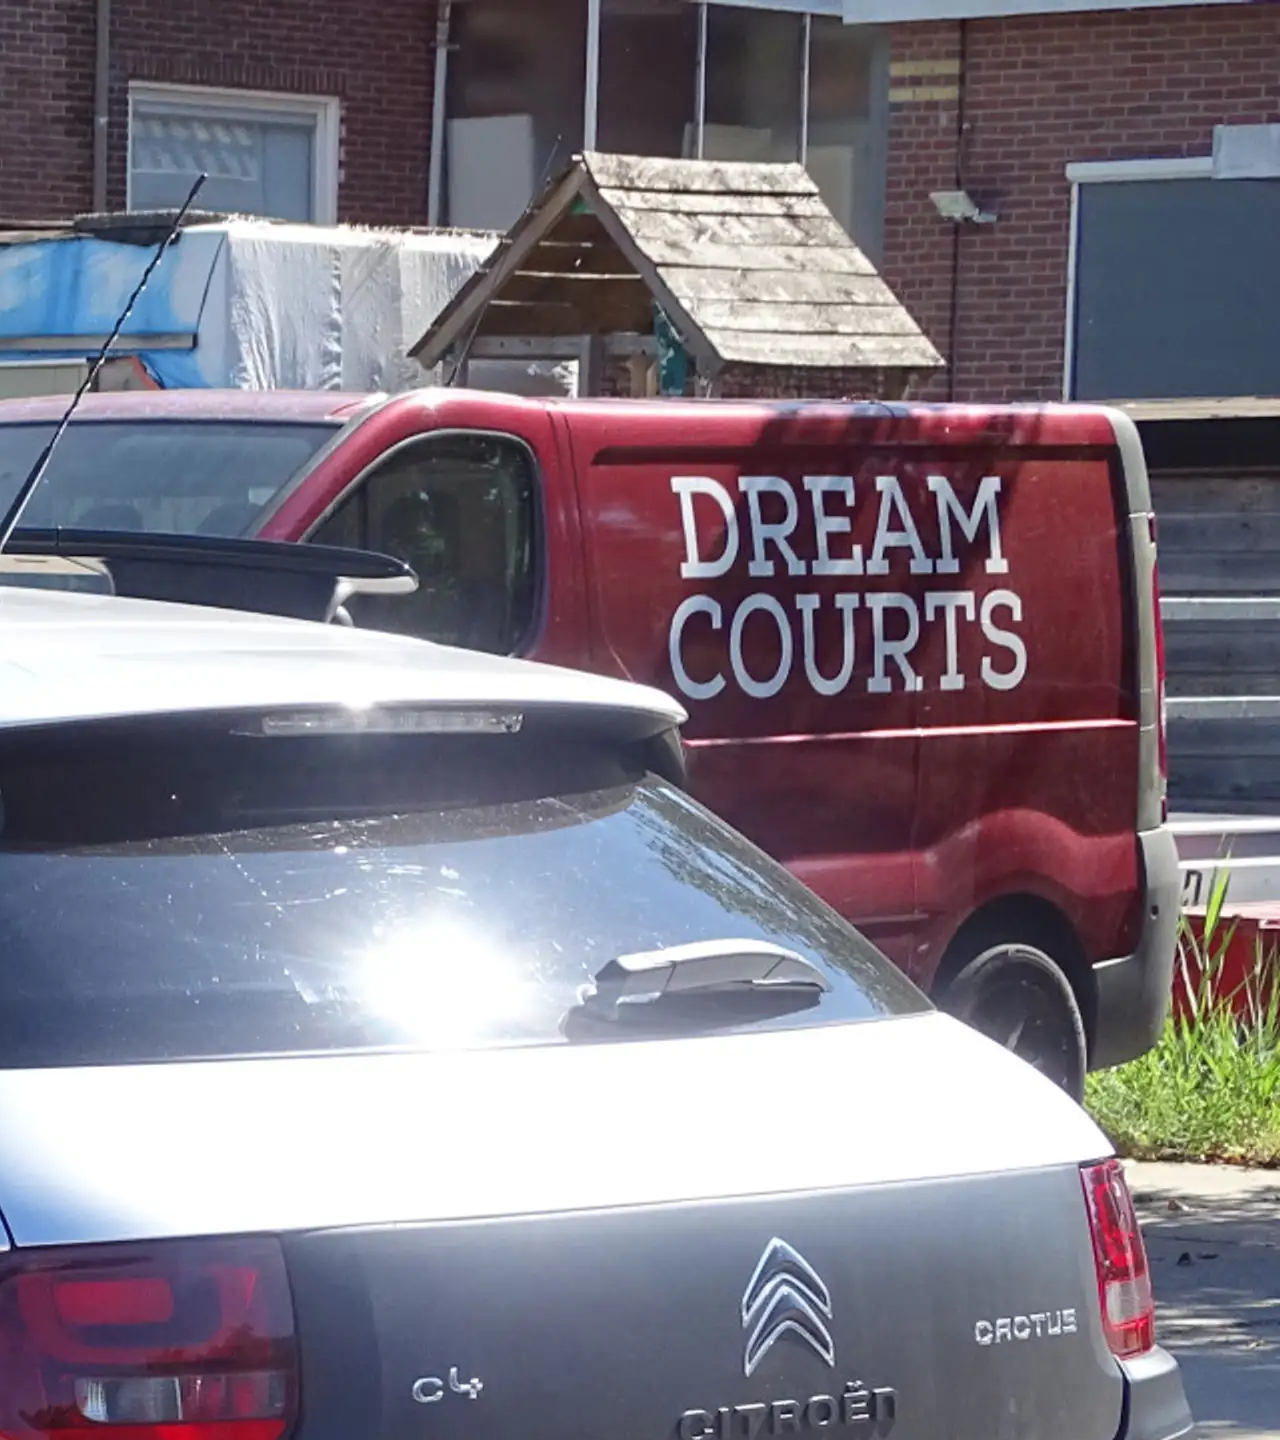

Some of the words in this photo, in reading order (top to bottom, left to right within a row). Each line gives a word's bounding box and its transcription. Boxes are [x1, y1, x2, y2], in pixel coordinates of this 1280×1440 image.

[670, 475, 1009, 579] DREAM
[668, 589, 1028, 700] COURTS
[974, 1308, 1078, 1346] CACTUS
